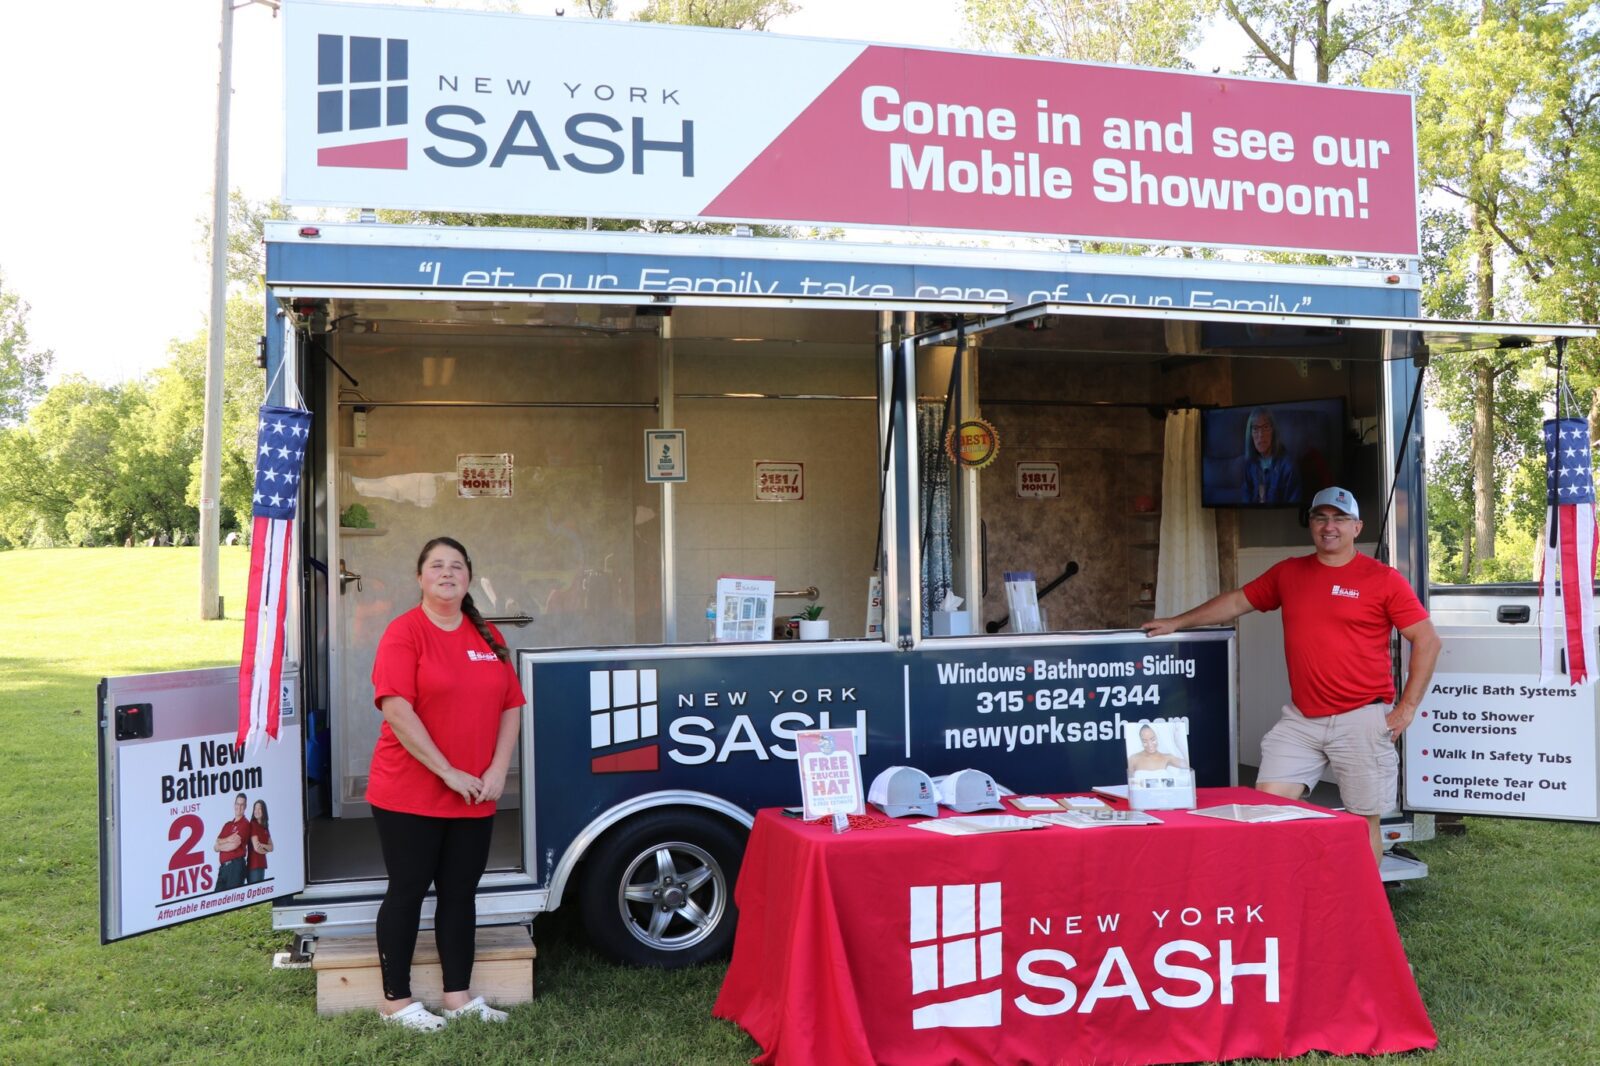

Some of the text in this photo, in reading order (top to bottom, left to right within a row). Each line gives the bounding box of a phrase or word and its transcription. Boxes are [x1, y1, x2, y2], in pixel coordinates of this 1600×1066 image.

[439, 74, 681, 105] NEW YORK
[860, 84, 1390, 169] Come in and see our
[423, 104, 694, 178] SASH
[889, 142, 1370, 220] Mobile Showroom!
[800, 275, 894, 297] take
[463, 480, 507, 489] MONTH
[937, 655, 1196, 684] Windows Bathrooms Siding
[678, 687, 857, 708] NEW YORK
[1431, 684, 1577, 699] Acrylic Bath Systems
[1432, 710, 1535, 723] Tub to Shower
[1432, 723, 1517, 735] Conversions
[667, 709, 867, 765] SASH
[178, 740, 246, 772] A New
[809, 756, 849, 772] FREE
[1433, 749, 1572, 764] Walk In Safety Tubs
[161, 766, 263, 804] Bathroom
[810, 770, 850, 780] TRUCKER
[812, 779, 850, 796] HAT
[1433, 775, 1567, 790] Complete Tear Out
[1433, 787, 1526, 802] and Remodel
[170, 803, 201, 816] IN JUST
[168, 814, 205, 871] 2
[161, 864, 213, 901] DAYS
[157, 884, 274, 921] Affordable Remodeling Options
[1029, 904, 1264, 935] NEW YORK
[1013, 936, 1280, 1017] SASH
